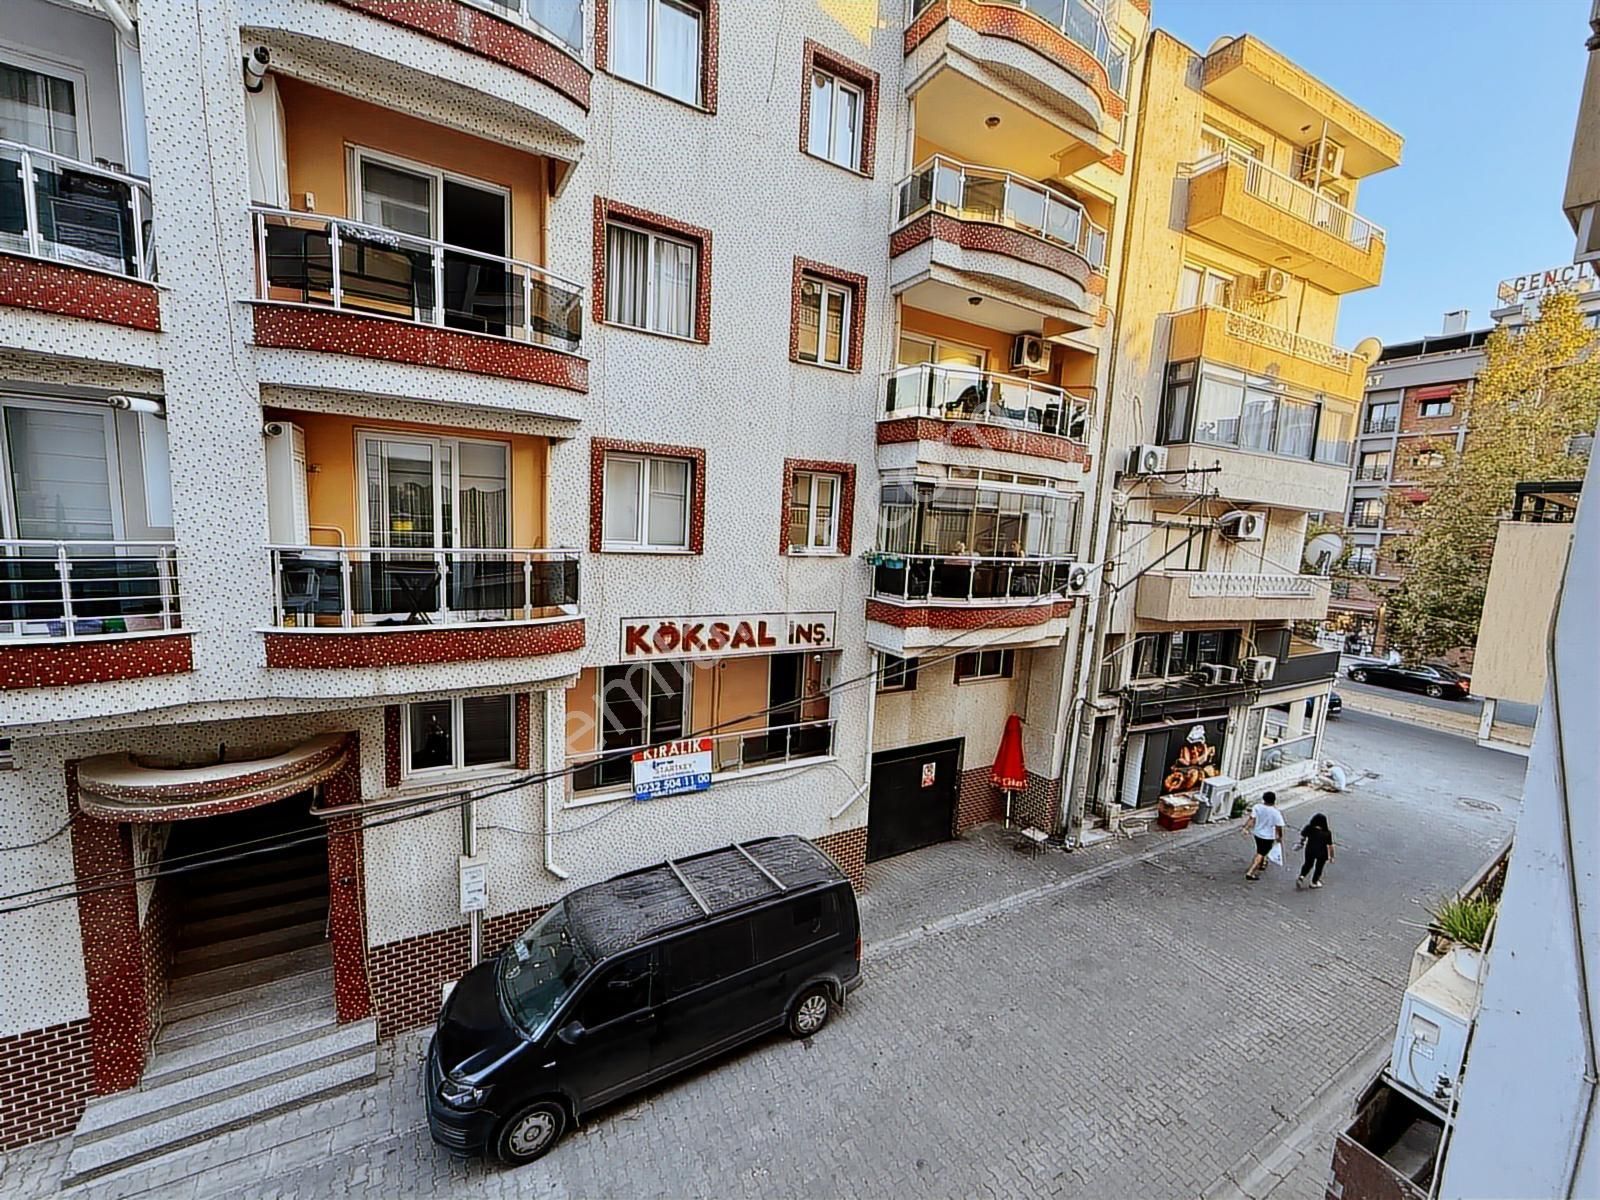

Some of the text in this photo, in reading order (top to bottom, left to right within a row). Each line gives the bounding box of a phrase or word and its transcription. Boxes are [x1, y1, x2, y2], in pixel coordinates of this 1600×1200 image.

[625, 621, 776, 655] KÖKSAL
[643, 739, 701, 760] KIRALIK
[636, 781, 661, 794] 0232
[664, 778, 681, 789] 504
[685, 775, 694, 786] 11
[698, 774, 710, 784] 00
